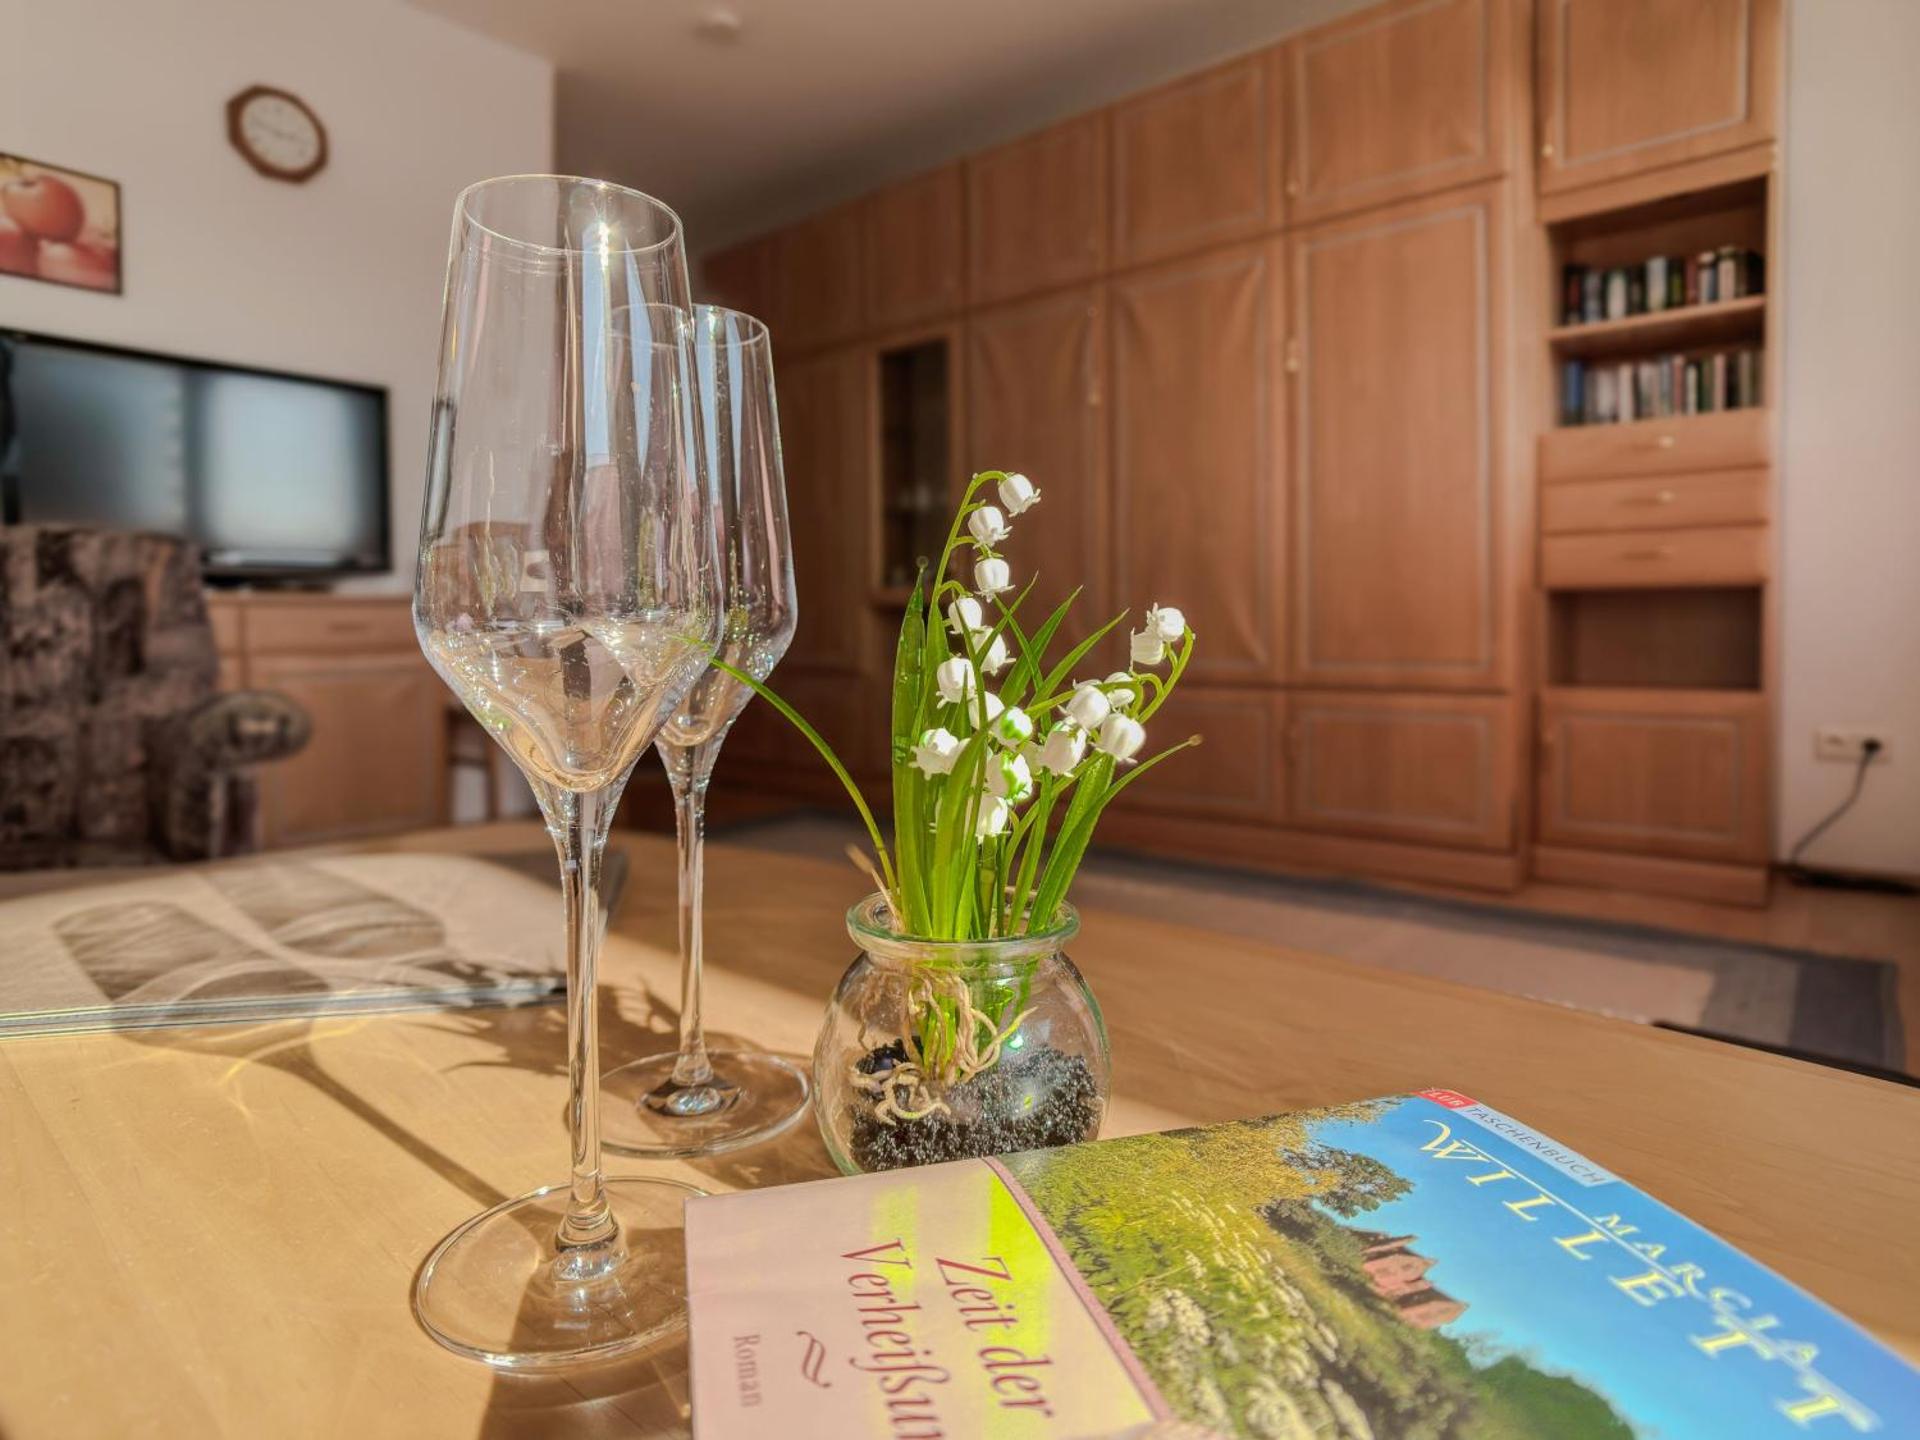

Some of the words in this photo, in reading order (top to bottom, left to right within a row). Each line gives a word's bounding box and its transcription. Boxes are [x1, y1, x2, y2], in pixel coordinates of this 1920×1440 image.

[1467, 1107, 1604, 1183] TASCHENBUCH
[1421, 1119, 1884, 1433] WILLETT
[734, 1334, 762, 1407] Roman
[936, 1256, 1018, 1331] Zeit
[977, 1347, 1054, 1418] der
